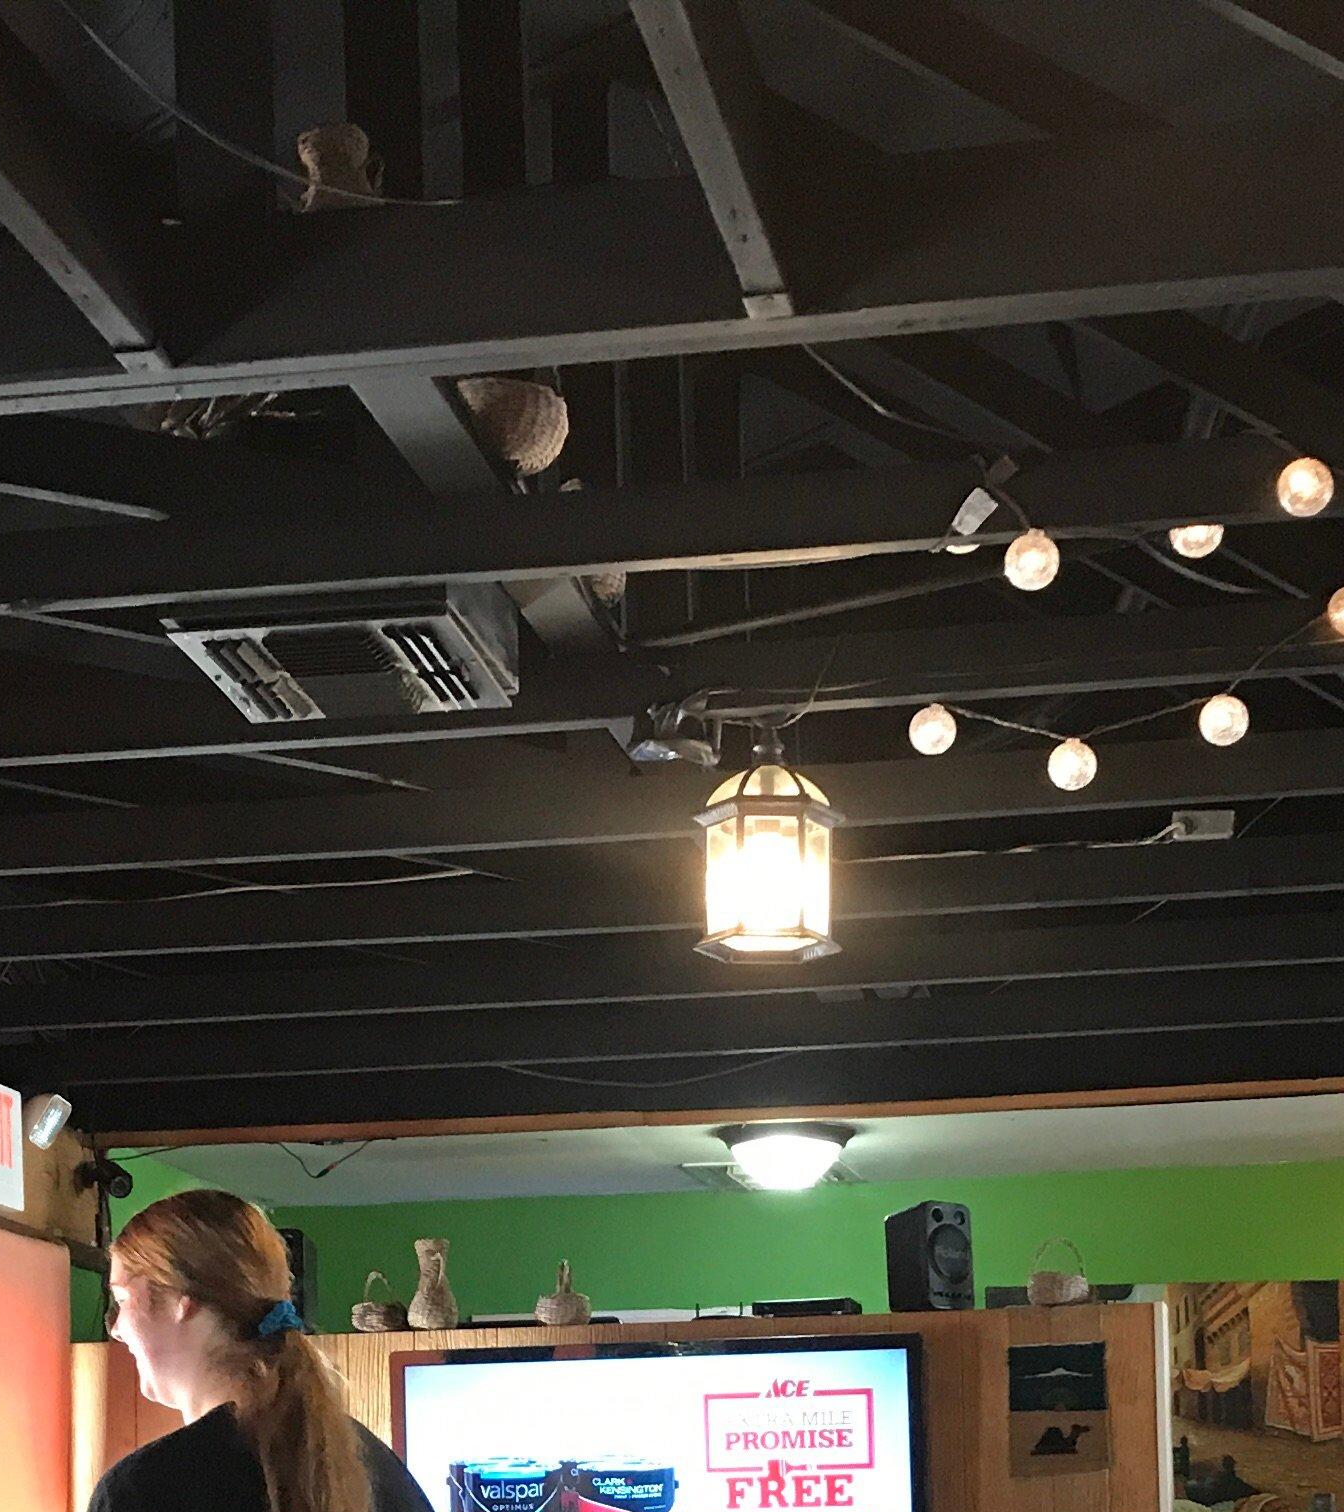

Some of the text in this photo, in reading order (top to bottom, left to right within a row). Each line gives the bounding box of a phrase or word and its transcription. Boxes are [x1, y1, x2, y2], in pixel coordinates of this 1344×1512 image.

[765, 1378, 810, 1398] ACE
[802, 1410, 854, 1426] MILE
[724, 1428, 854, 1451] PROMISE
[480, 1480, 546, 1502] valspar
[592, 1477, 626, 1487] CLARK
[599, 1483, 664, 1496] KENSINGTON
[726, 1473, 854, 1509] FREE
